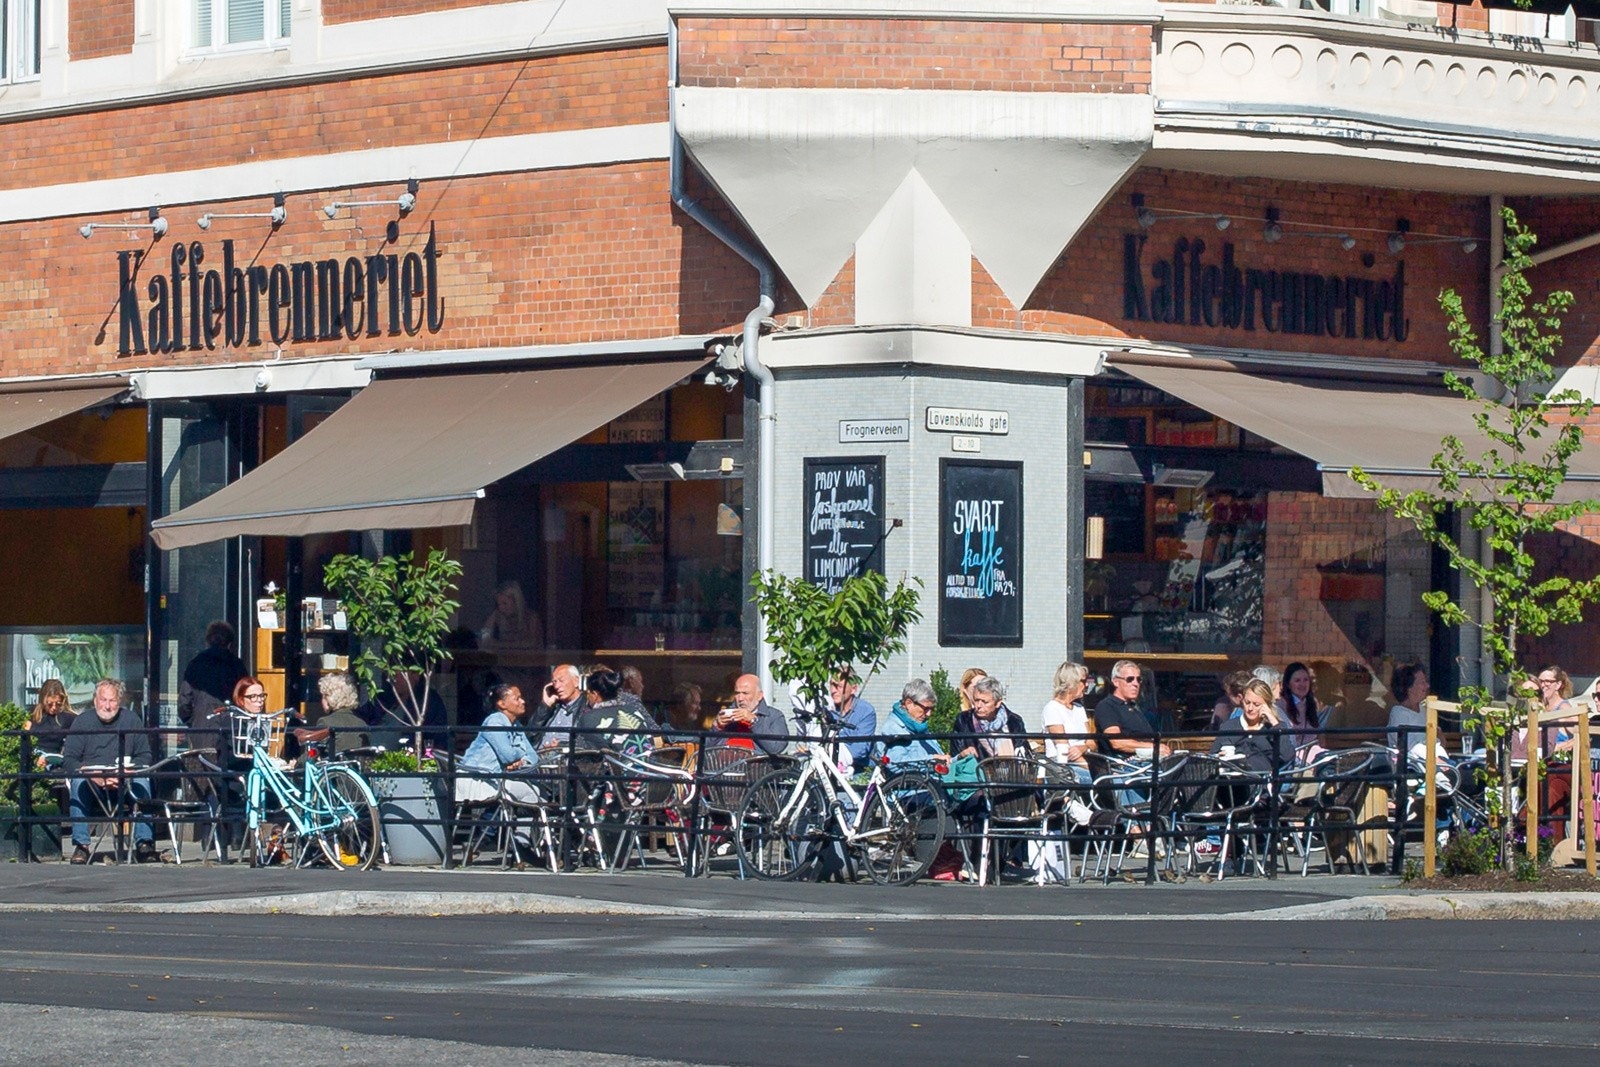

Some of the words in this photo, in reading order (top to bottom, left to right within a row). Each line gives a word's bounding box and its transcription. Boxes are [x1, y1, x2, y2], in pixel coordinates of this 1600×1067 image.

[117, 220, 445, 357] Kaffebrenneriet
[1123, 233, 1410, 343] Kaffebrenneriet
[846, 423, 903, 438] Frognerveien
[989, 414, 1007, 431] gate
[845, 466, 866, 488] VÅR
[953, 499, 1004, 535] SVART
[828, 531, 849, 556] eller
[961, 525, 1004, 597] kaffe
